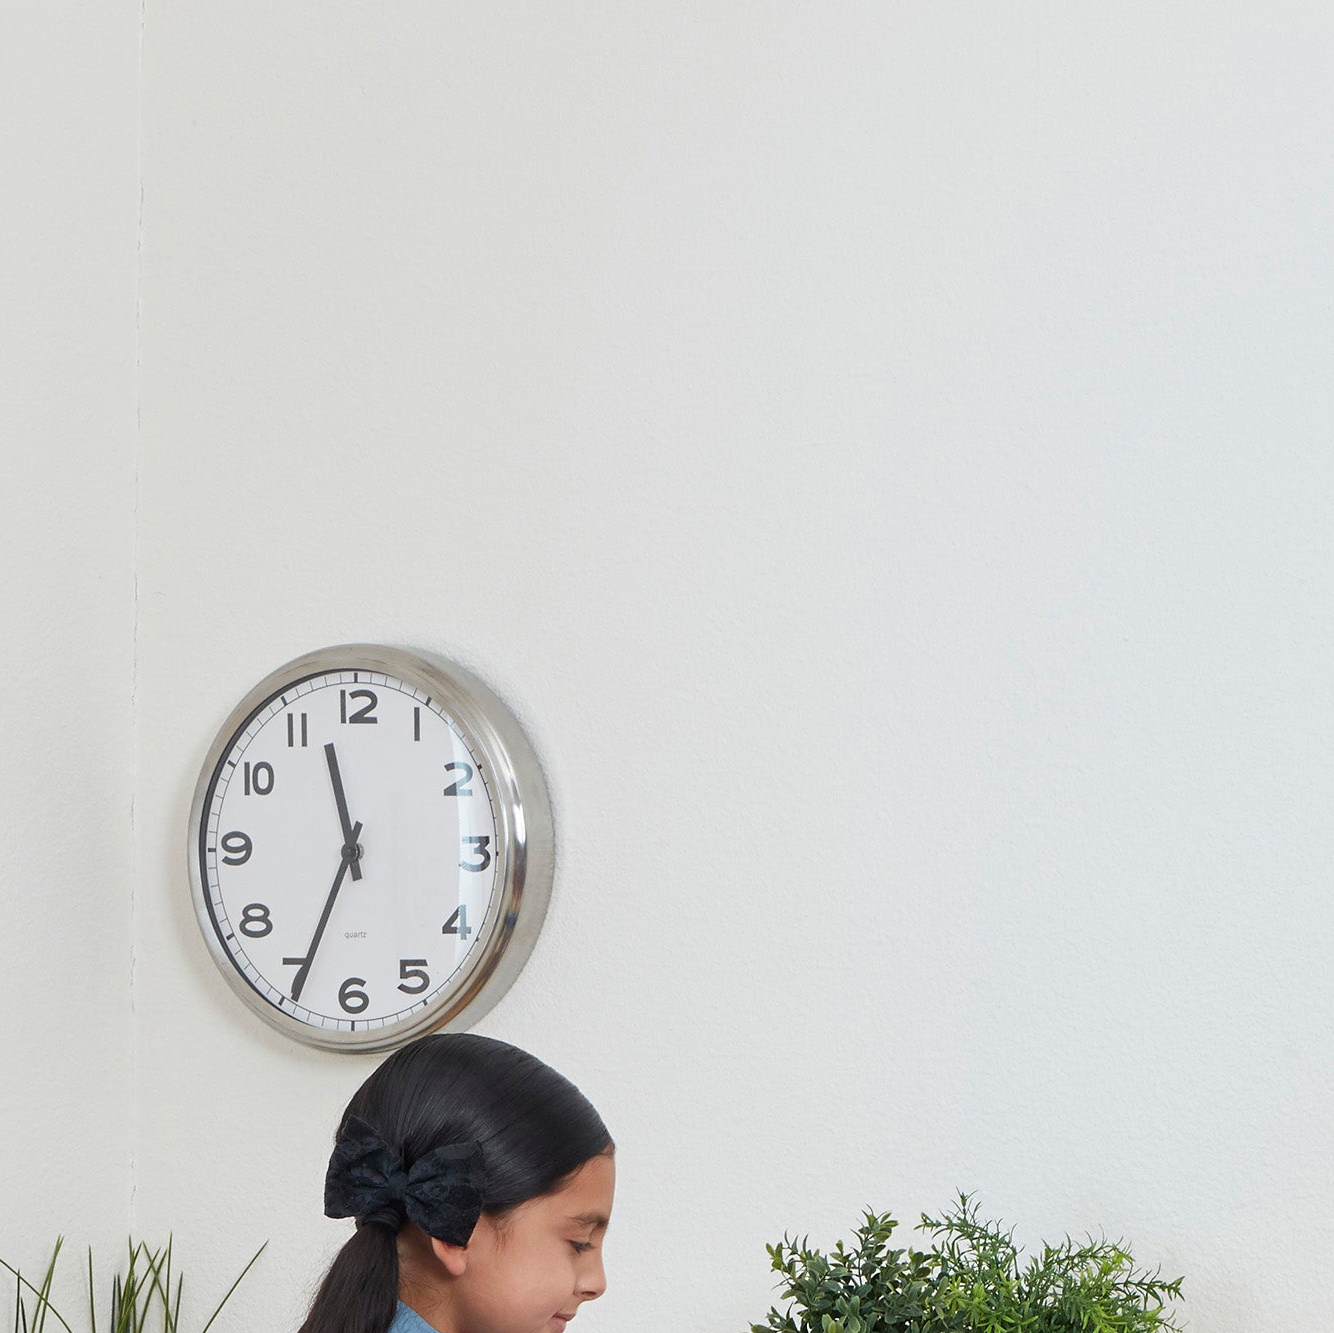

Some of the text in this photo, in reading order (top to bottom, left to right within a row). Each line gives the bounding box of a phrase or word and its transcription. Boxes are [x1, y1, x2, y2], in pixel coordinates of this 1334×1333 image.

[340, 690, 378, 724] 12
[413, 706, 421, 742] 1
[287, 713, 307, 747] 11
[244, 762, 274, 795] 10
[444, 762, 473, 796] 2
[221, 831, 252, 866] 9
[460, 835, 491, 873] 3
[239, 903, 273, 938] 8
[344, 931, 367, 939] quartz
[442, 904, 472, 940] 4
[397, 959, 430, 994] 5
[338, 978, 369, 1014] 6
